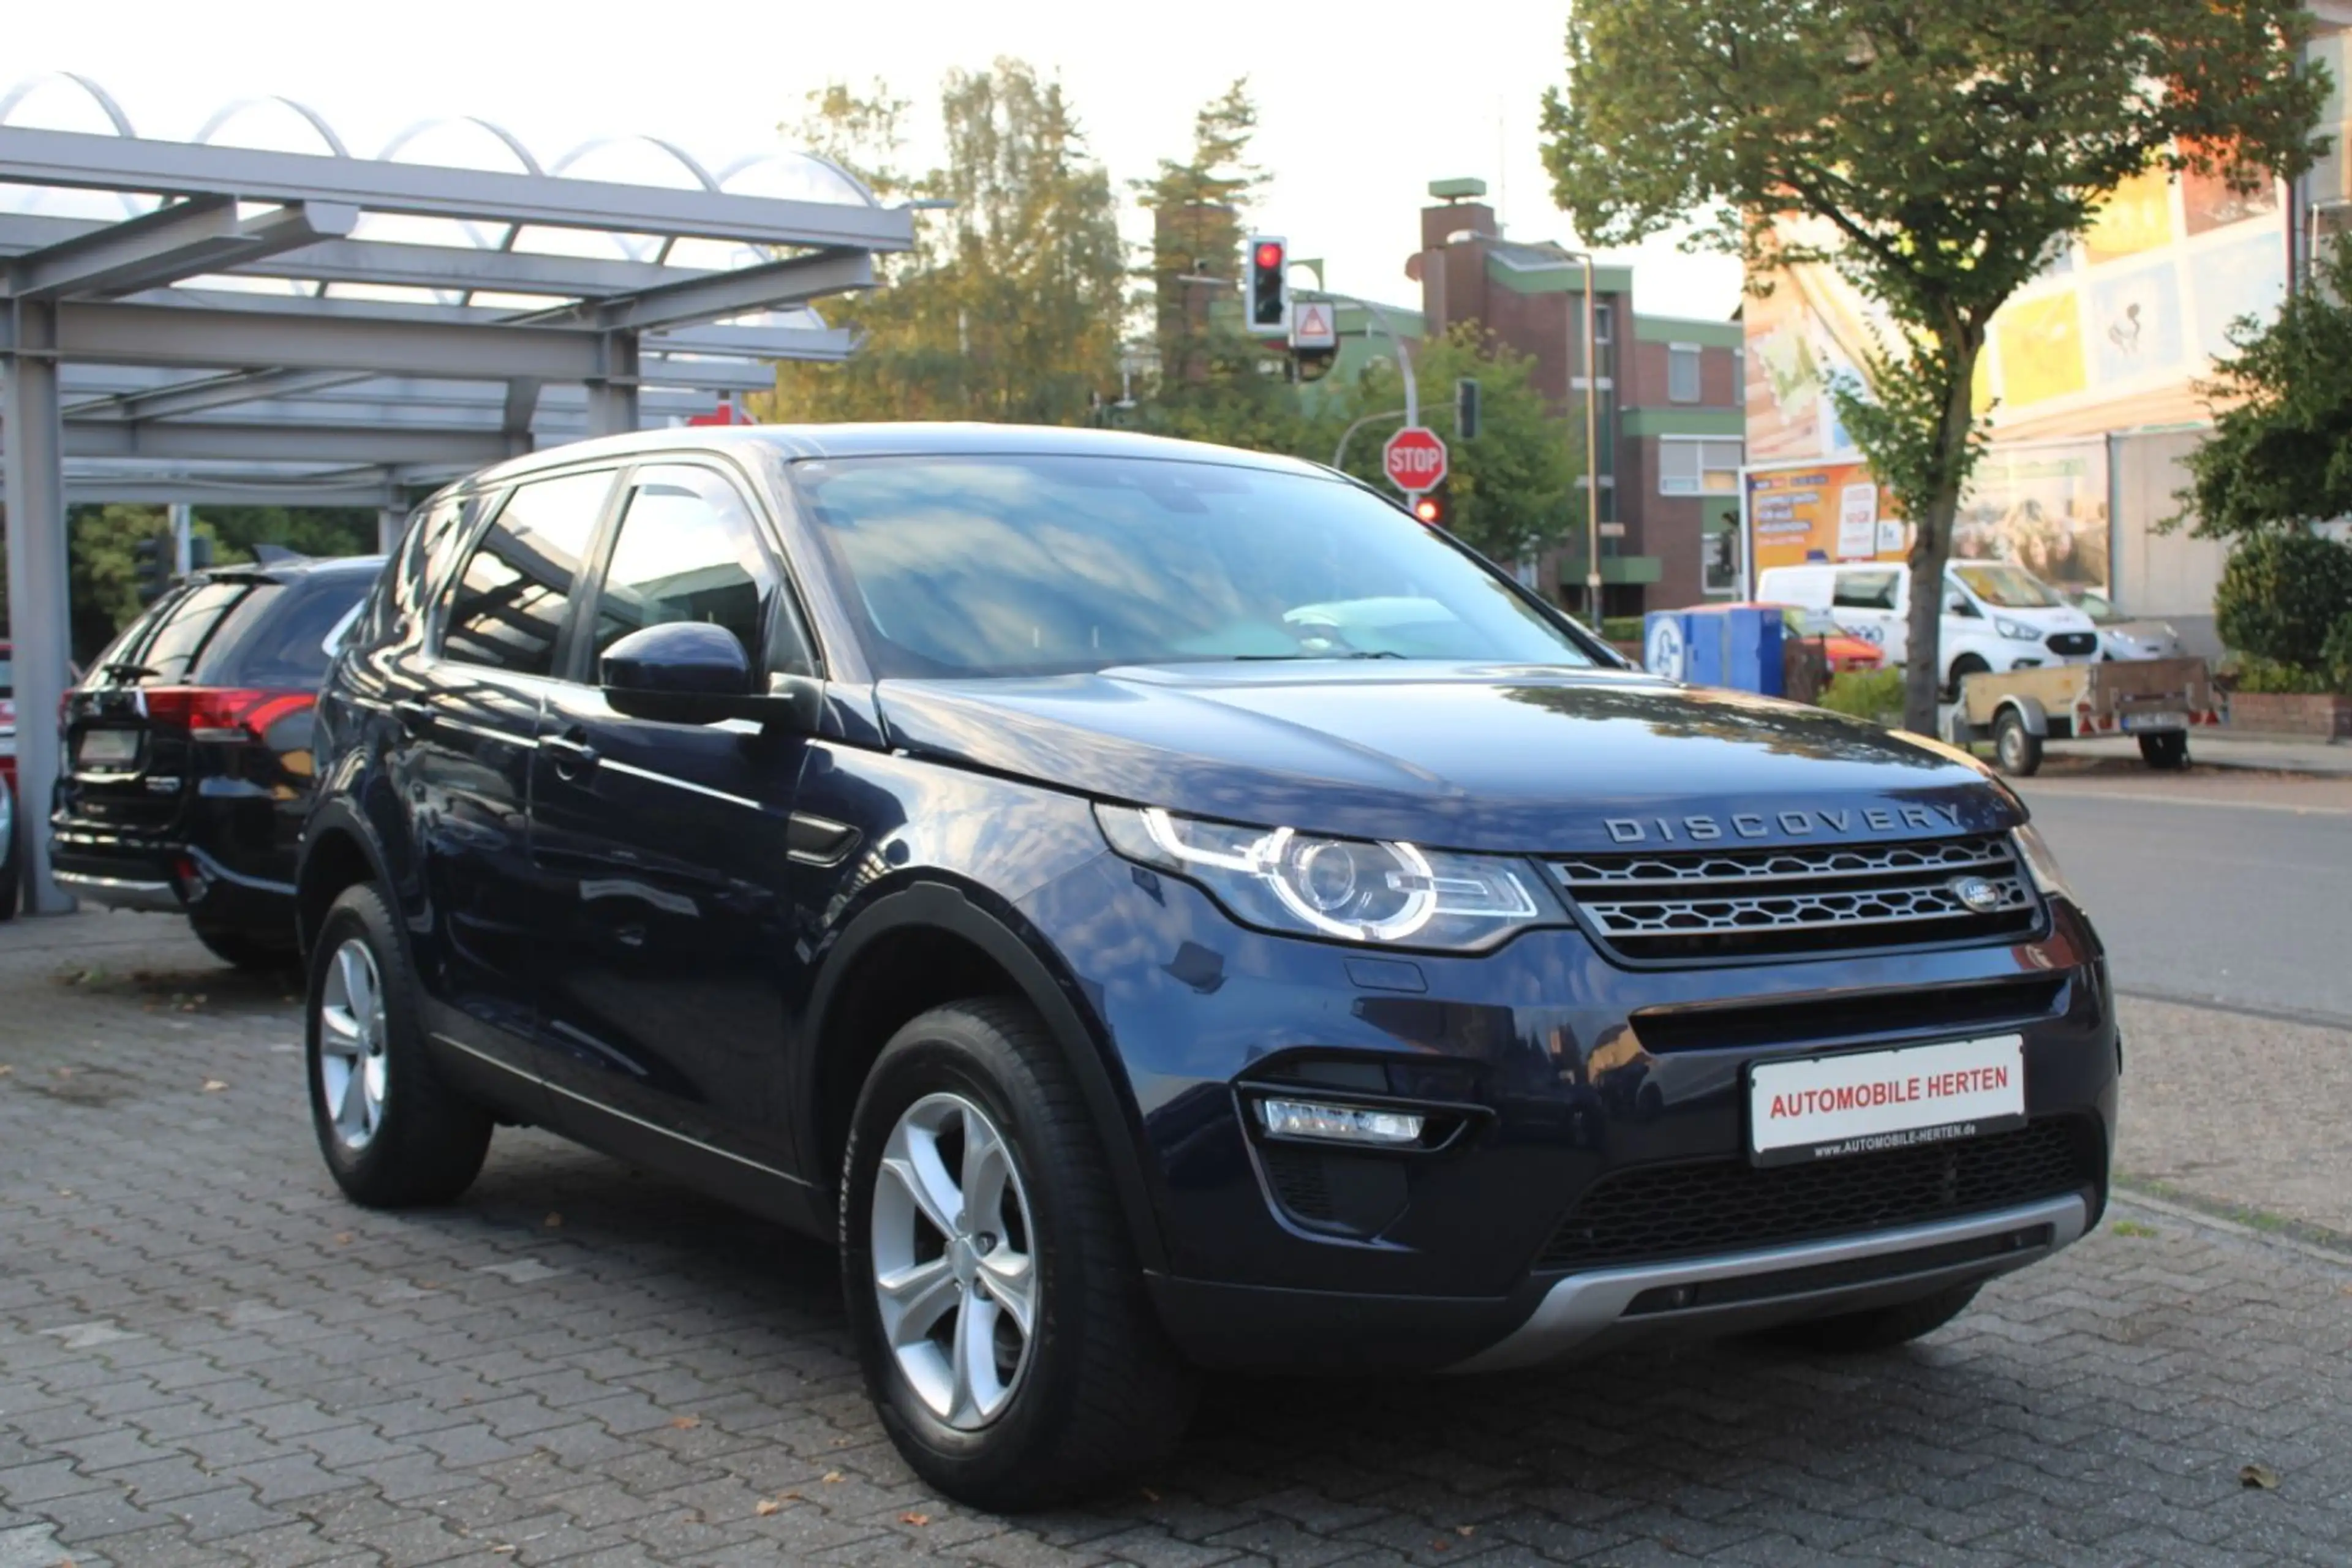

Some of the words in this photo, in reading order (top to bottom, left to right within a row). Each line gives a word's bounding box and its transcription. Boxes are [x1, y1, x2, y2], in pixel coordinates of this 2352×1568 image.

[1390, 447, 1440, 472] STOP
[1605, 804, 1959, 843] DISCOVERY
[1770, 1077, 1921, 1118] AUTOMOBILE
[1927, 1066, 2008, 1098] HERTEN
[1814, 1123, 1976, 1157] www.AUTOMOBILE-HERTEN.de
